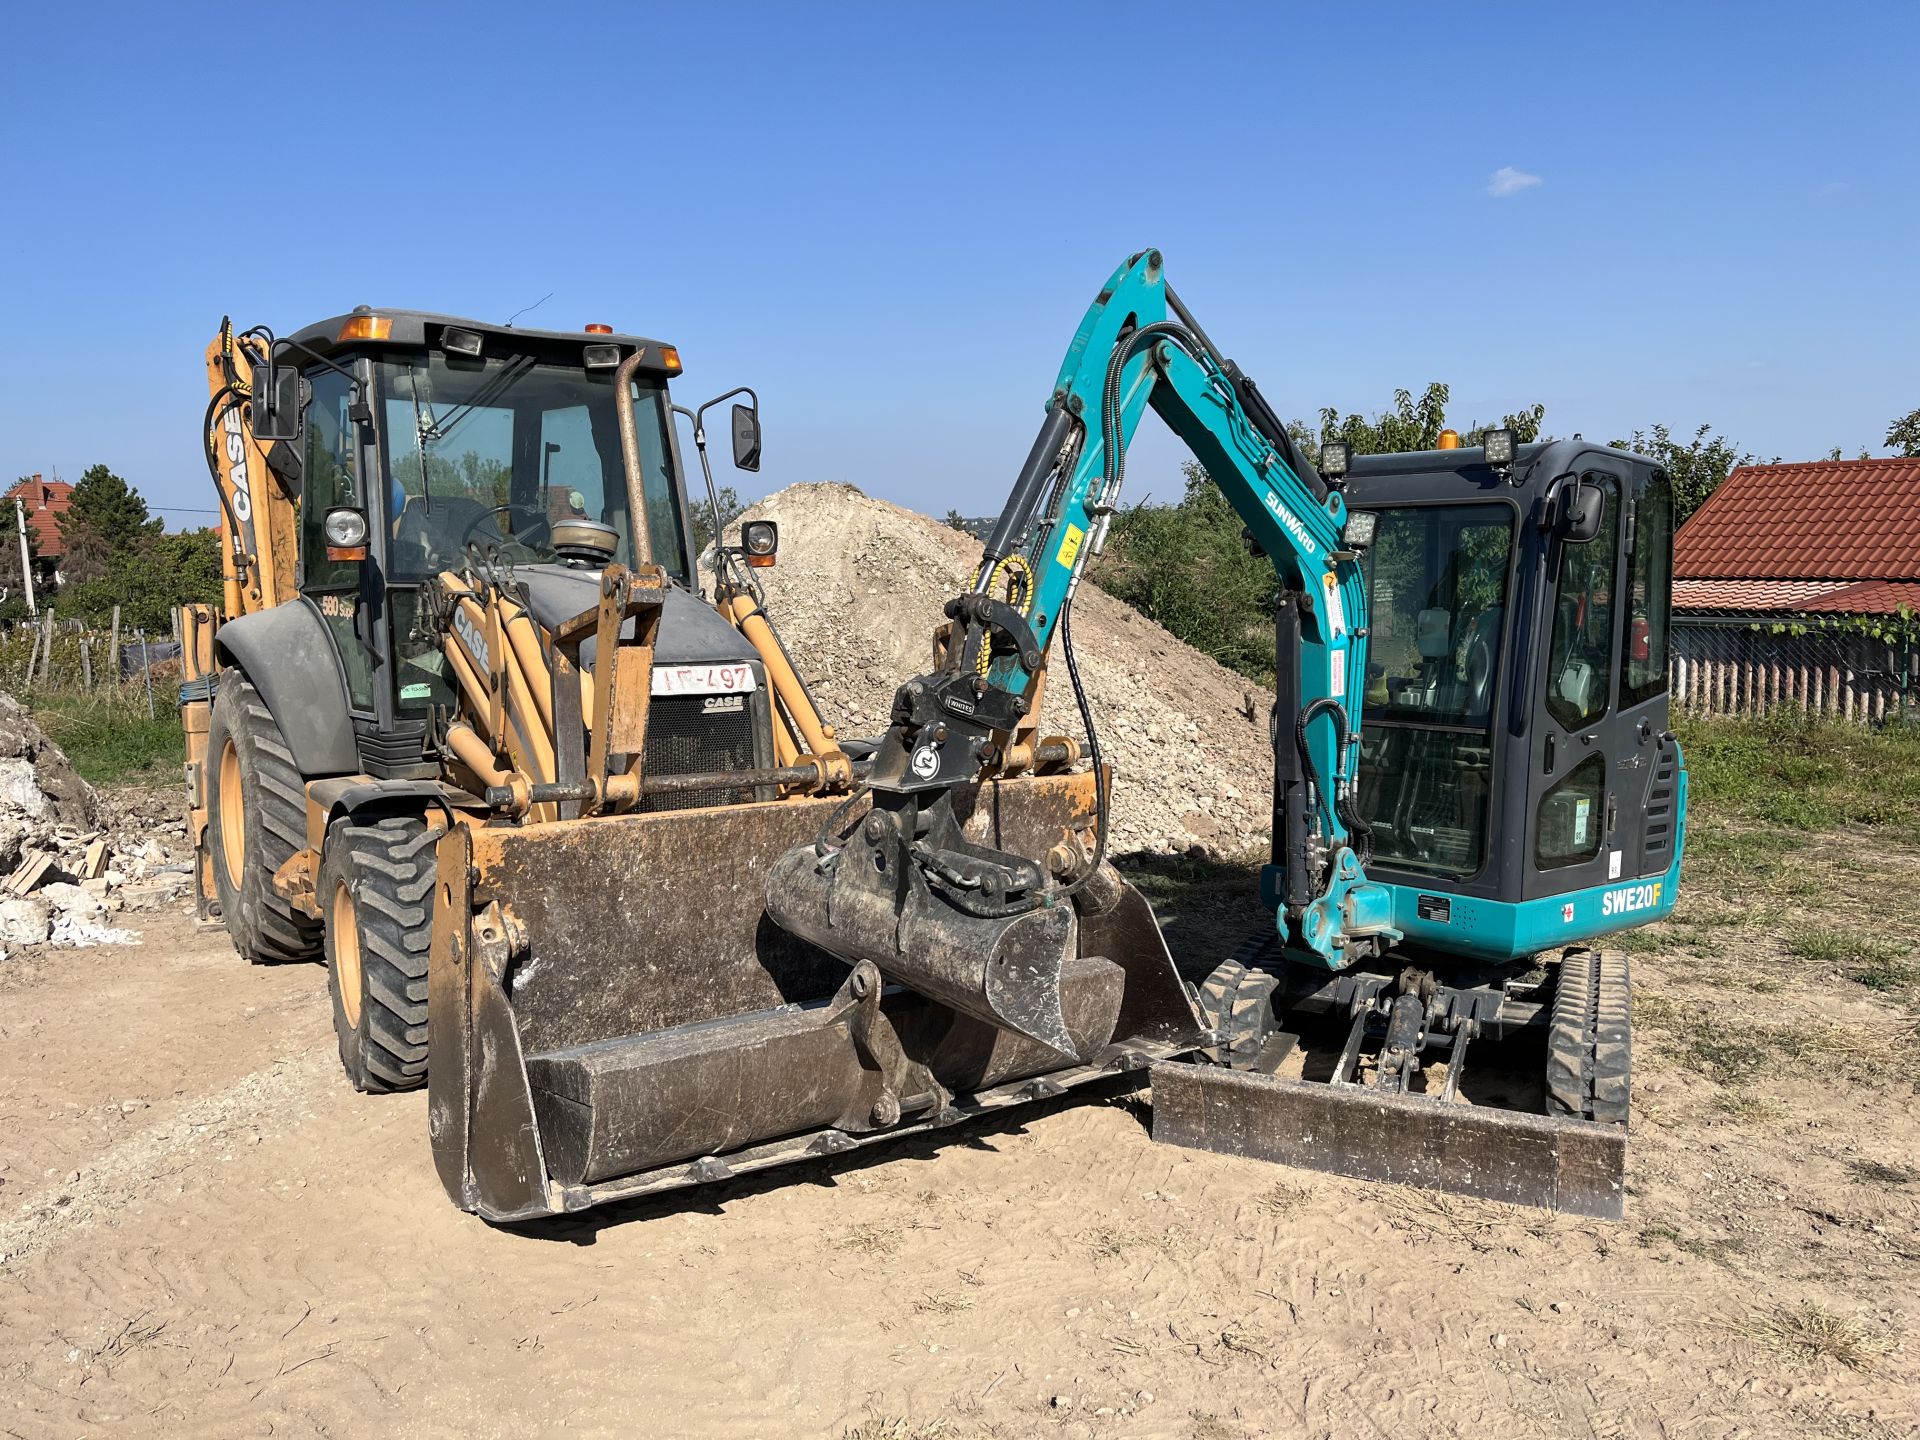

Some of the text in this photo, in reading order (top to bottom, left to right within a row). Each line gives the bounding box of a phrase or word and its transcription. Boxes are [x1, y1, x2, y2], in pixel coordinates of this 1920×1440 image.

[222, 404, 252, 522] CASE
[1264, 491, 1316, 553] SUNWARD
[322, 595, 339, 617] 580
[454, 605, 490, 676] CASE
[704, 695, 744, 708] CASE
[1602, 882, 1662, 916] SWE20F
